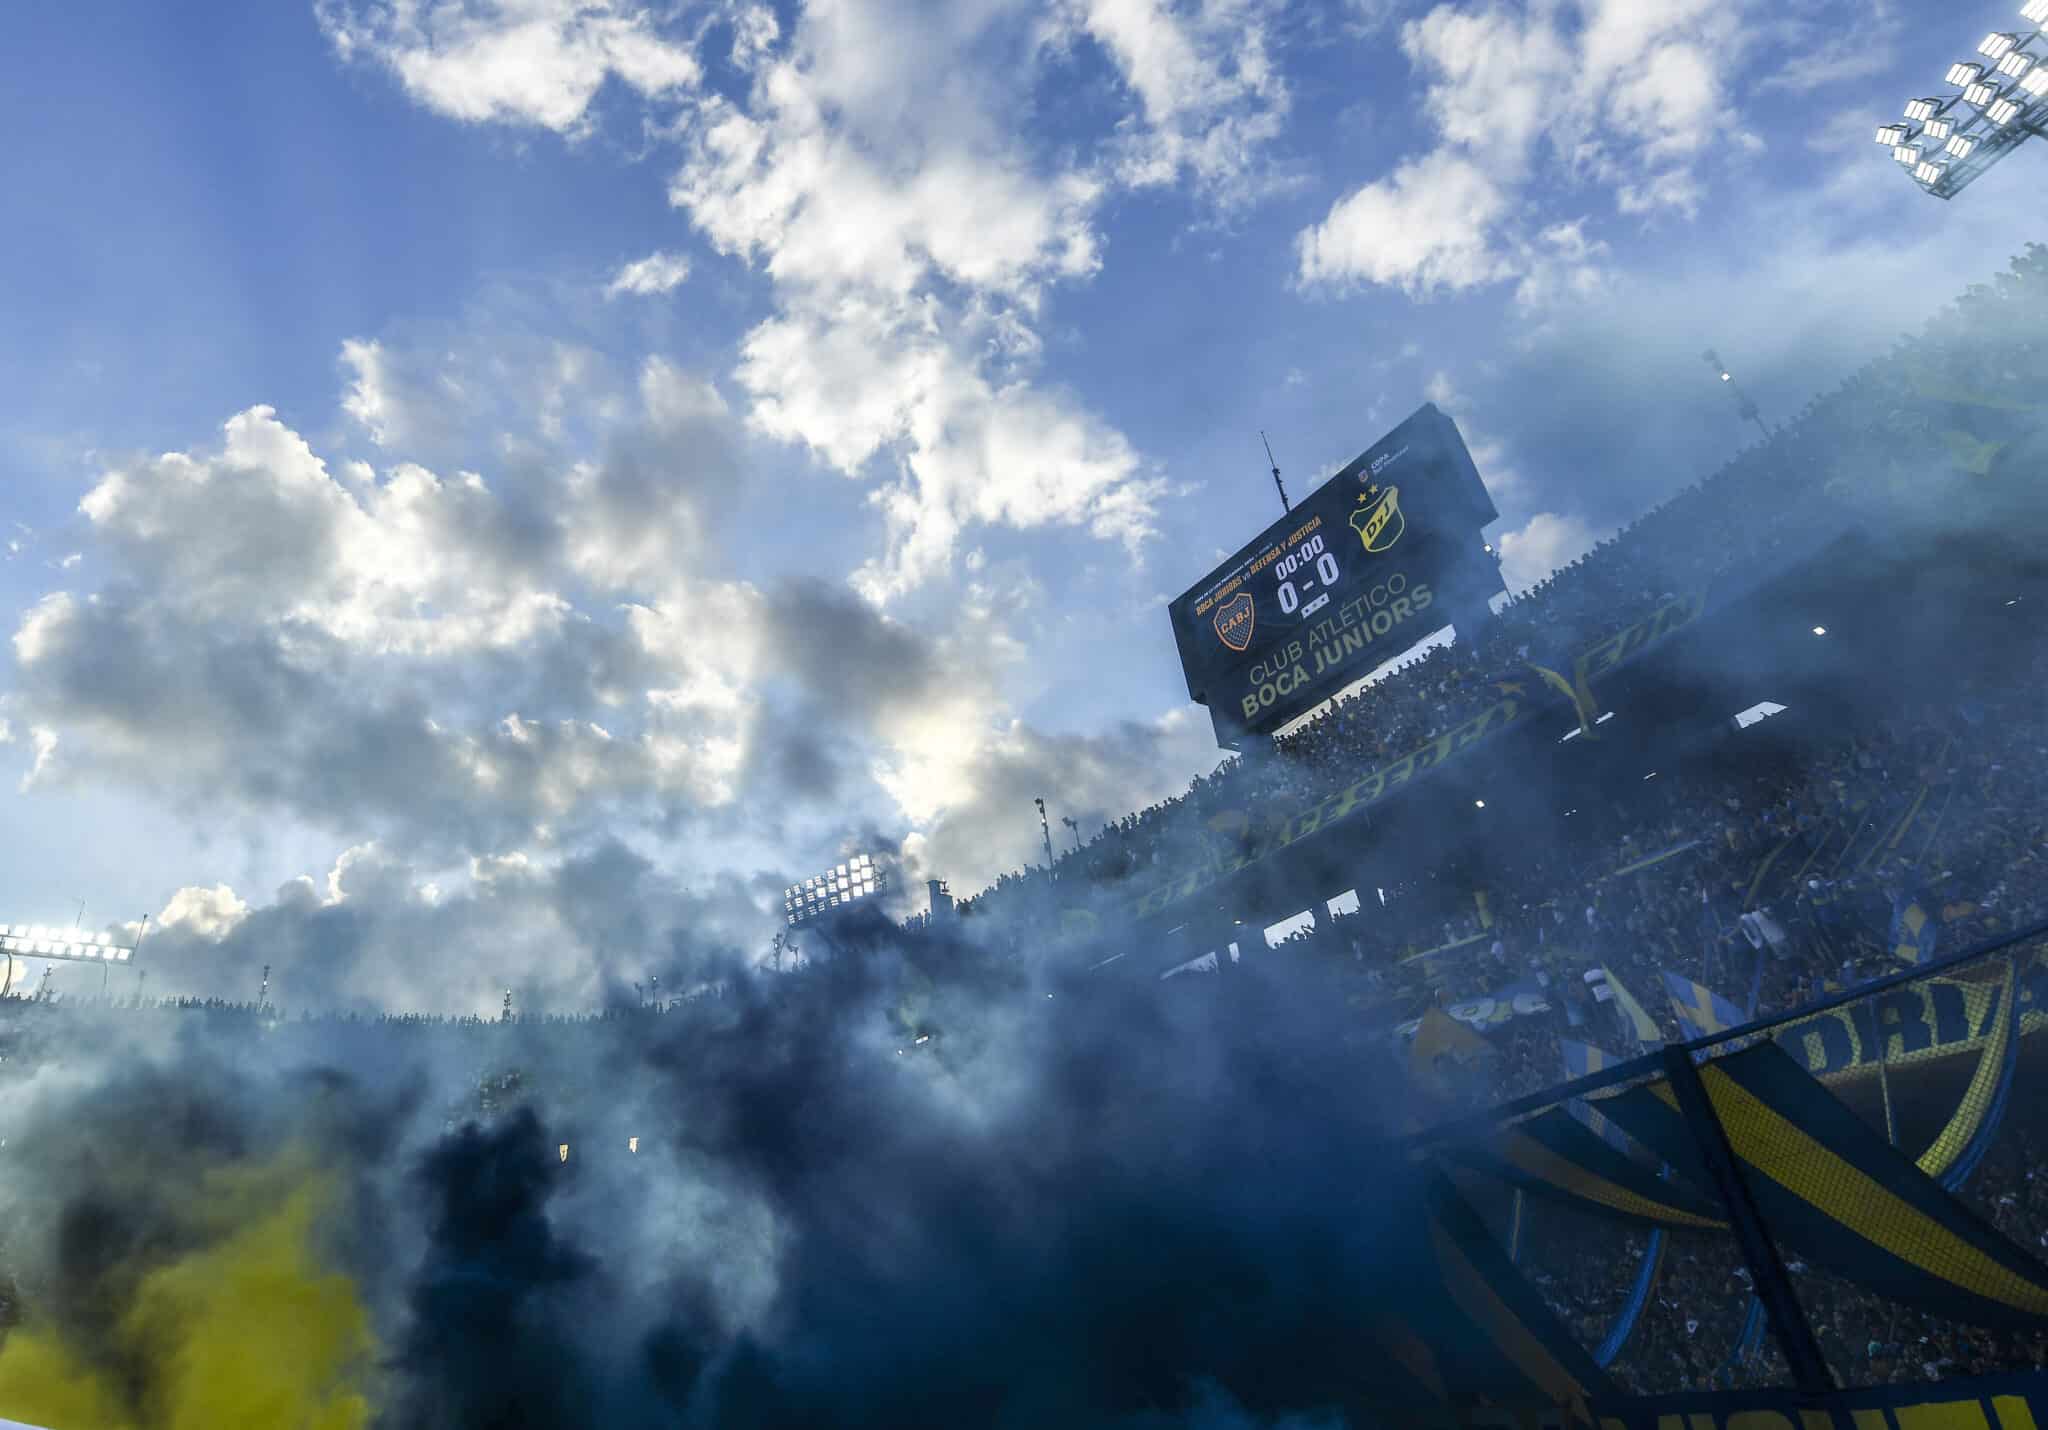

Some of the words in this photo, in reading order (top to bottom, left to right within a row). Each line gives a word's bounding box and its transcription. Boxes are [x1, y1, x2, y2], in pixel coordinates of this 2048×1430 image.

[1195, 597, 1214, 616] BOCA
[1214, 575, 1242, 602] JUNIORS
[1250, 546, 1281, 575] DEFENSA
[1288, 515, 1321, 546] JUSTICIA
[1275, 534, 1324, 580] 00:00
[1221, 606, 1249, 634] CABJ
[1242, 664, 1311, 719] BOCA
[1313, 583, 1433, 674] JUNIORS
[1250, 640, 1303, 686] CLUB
[1309, 573, 1406, 650] ATLÉTICO
